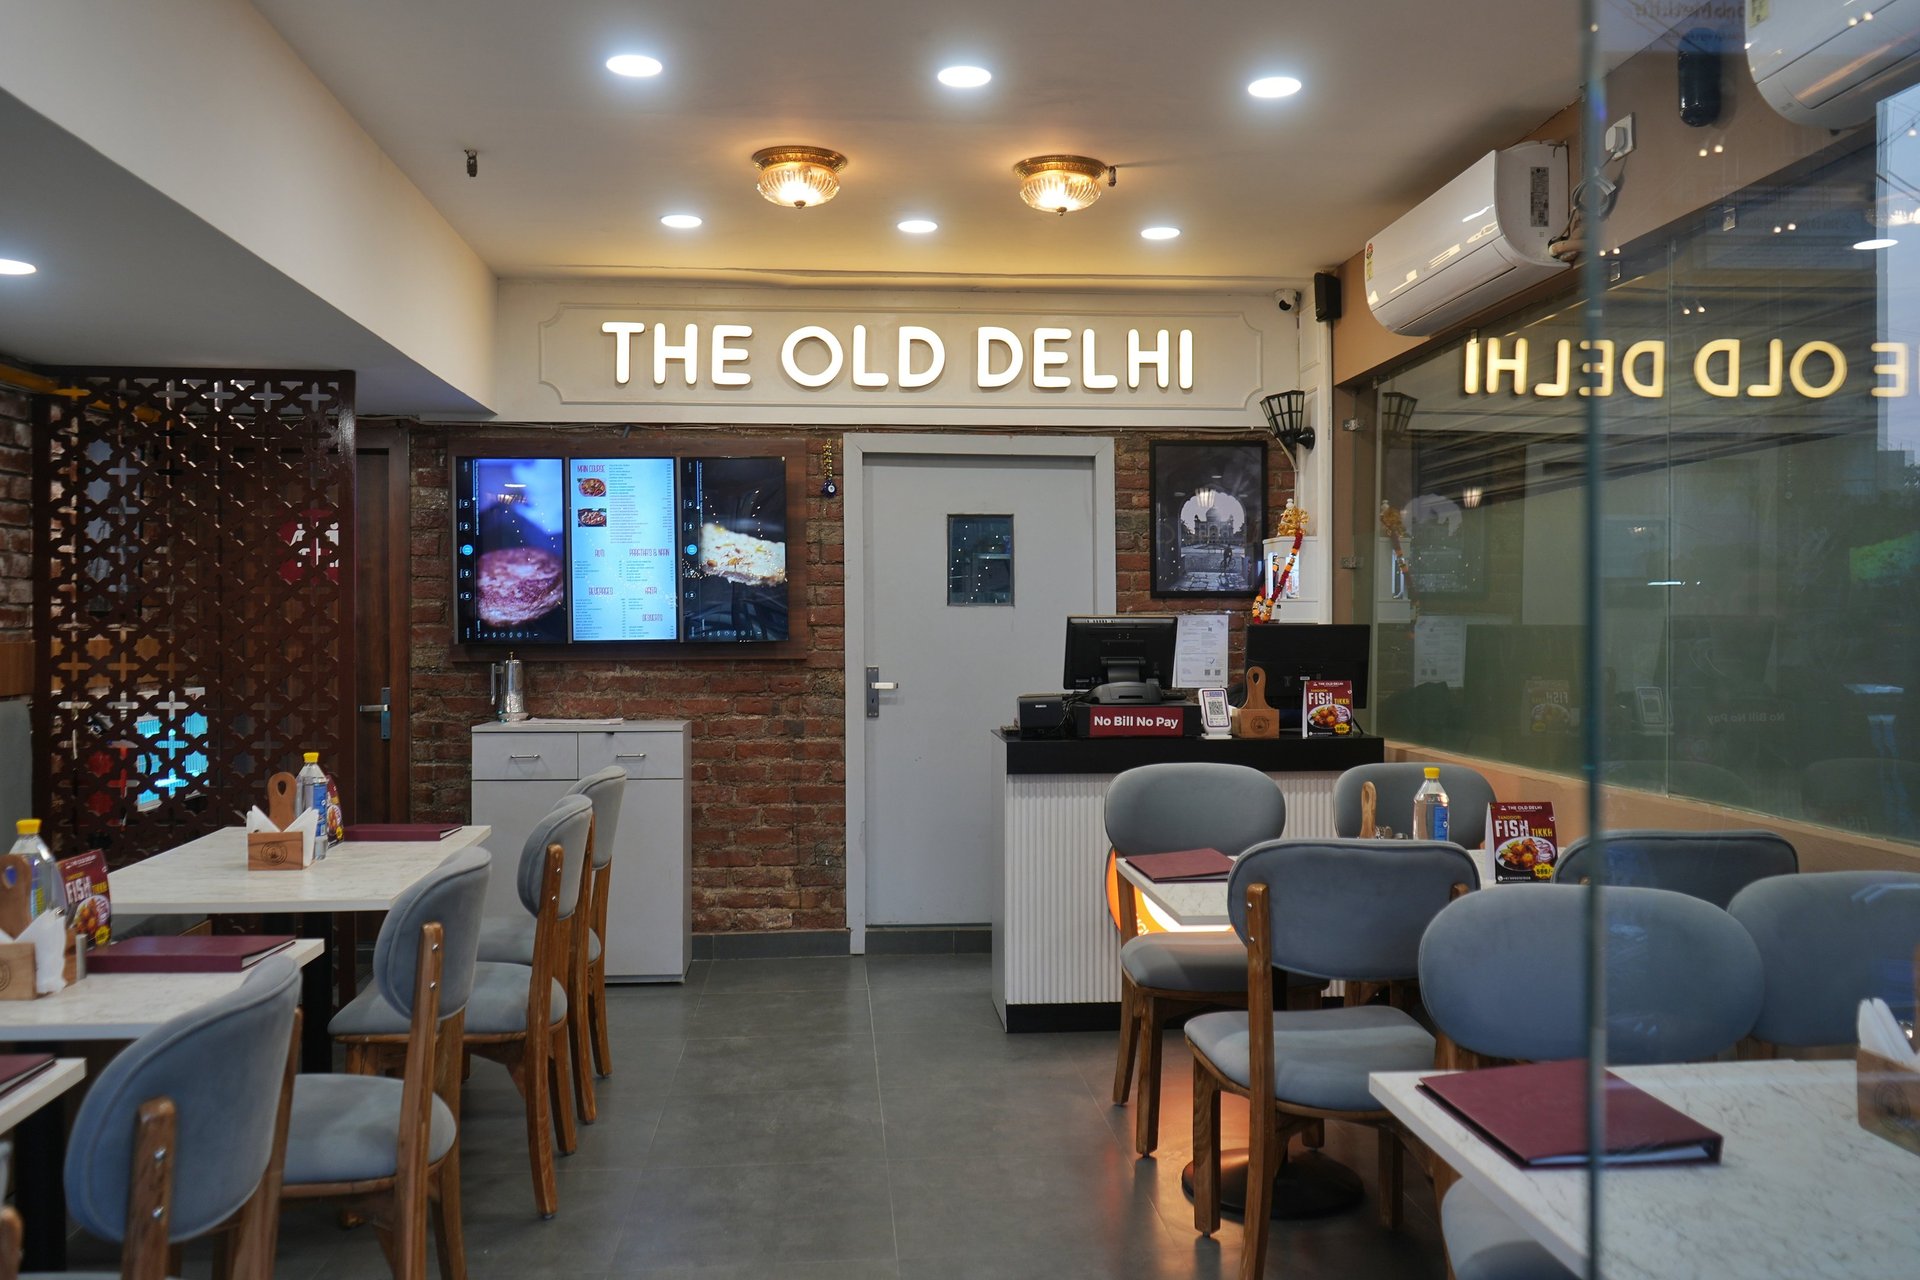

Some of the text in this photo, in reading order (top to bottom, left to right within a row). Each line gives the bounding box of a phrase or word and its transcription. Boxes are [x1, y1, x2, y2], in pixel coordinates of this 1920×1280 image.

[602, 321, 1193, 389] THE OLD DELHI
[1308, 692, 1333, 705] FISH
[1094, 715, 1178, 729] No Bill No Pay
[1495, 819, 1529, 838] FISH
[65, 876, 92, 904] FISH
